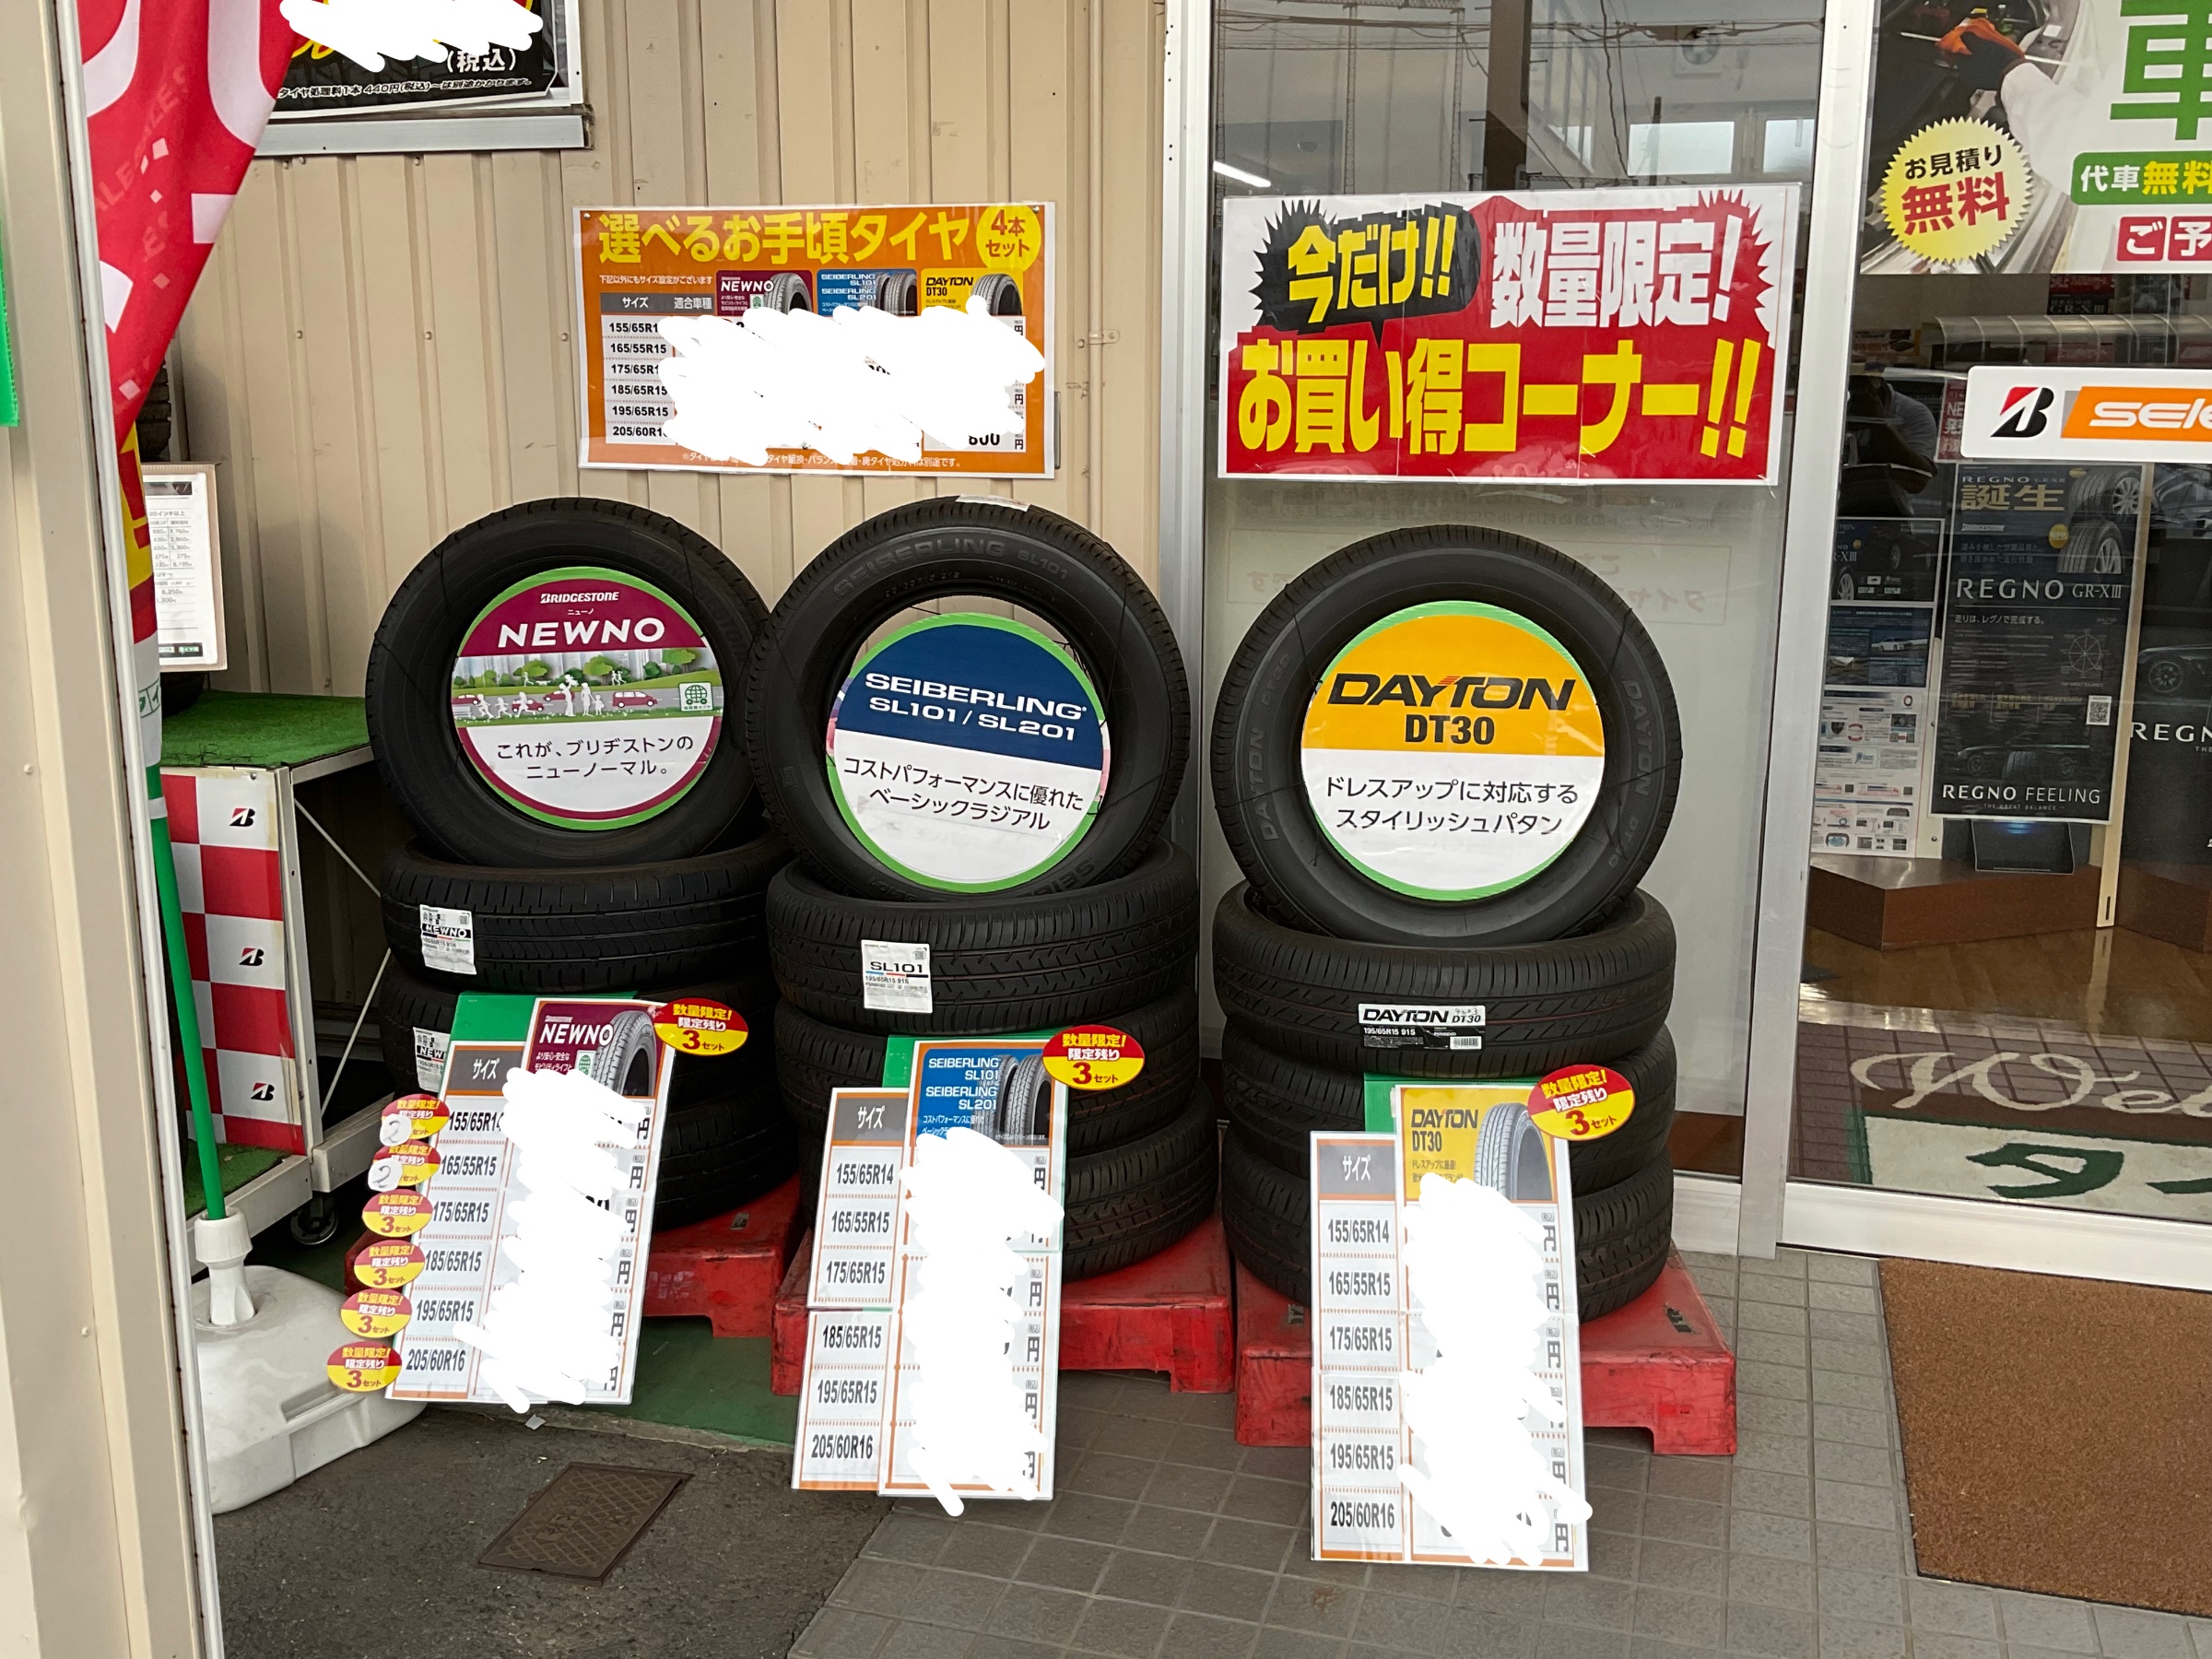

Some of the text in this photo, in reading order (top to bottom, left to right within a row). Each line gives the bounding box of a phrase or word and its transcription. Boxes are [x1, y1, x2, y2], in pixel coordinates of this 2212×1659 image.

[1904, 144, 2003, 180] お見積り
[1900, 171, 2010, 236] 無料
[599, 212, 970, 265] 選べるお手頃タイヤ
[991, 217, 1026, 238] 4本
[985, 240, 1030, 257] セット
[1288, 214, 1458, 324] 今だけ!!
[1490, 215, 1742, 328] 数量限定!
[721, 280, 774, 292] NEWNO
[925, 276, 973, 287] DAYTON
[926, 287, 947, 297] DT30
[621, 297, 649, 309] サイズ
[674, 297, 712, 310] 適合車種
[610, 343, 667, 354] 165/55R15
[611, 384, 668, 395] 185/65R15
[1238, 337, 1760, 459] お買い得コーナー!!
[612, 406, 669, 417] 195/65R15
[1960, 484, 2065, 512] 誕生
[540, 591, 620, 605] BRIDGESTONE
[1956, 578, 2065, 600] REGNO
[566, 607, 595, 617] ニューノ
[498, 617, 665, 648] NEWNO
[865, 672, 1088, 721] SEIBERLING
[1326, 673, 1576, 711] DAYTON
[868, 696, 956, 724] SL101
[977, 712, 1076, 741] SL201
[1405, 714, 1495, 746] DT30
[497, 735, 694, 760] これが、ブリヂストンの
[526, 759, 669, 780] ニューノーマル。
[843, 756, 1084, 812] コストパフォーマンスに優れた
[1325, 776, 1579, 806] ドレスアップに対応する
[1942, 783, 2101, 804] REGNO FEELING
[869, 785, 1052, 831] ベーシックラジアル
[1335, 807, 1563, 837] スタイリッシュパタン
[425, 924, 467, 938] NEWNO
[870, 960, 923, 973] SL101
[672, 1003, 733, 1021] 数量限定!
[1362, 1008, 1449, 1023] DAYTON
[1452, 1014, 1481, 1023] DT30
[539, 1023, 614, 1046] NEWNO
[677, 1017, 726, 1032] 限定残り
[1363, 1027, 1416, 1036] 195/65R15 91S
[1062, 1033, 1126, 1048] 数量限定!
[928, 1057, 999, 1069] SEIBERLING
[1066, 1048, 1121, 1061] 限定残り
[472, 1057, 500, 1081] サイズ
[964, 1069, 999, 1081] SL101
[925, 1086, 998, 1098] SEIBERLING
[1540, 1069, 1608, 1100] 数量限定!
[958, 1099, 997, 1111] SL201
[1552, 1087, 1608, 1112] 限定残り
[857, 1106, 885, 1130] サイズ
[1410, 1108, 1479, 1129] DAYTON
[1412, 1130, 1442, 1152] DT30
[441, 1154, 496, 1177] 165/55R15
[836, 1162, 894, 1186] 155/65R14
[1342, 1154, 1372, 1182] サイズ
[378, 1194, 424, 1206] 数量限定!
[379, 1206, 417, 1216] 限定残り
[433, 1200, 489, 1224] 175/65R15
[830, 1210, 890, 1234] 165/55R15
[1327, 1218, 1390, 1244] 155/65R14
[369, 1245, 415, 1257] 数量限定!
[371, 1256, 409, 1268] 限定残り
[425, 1249, 483, 1273] 185/65R15
[826, 1260, 1042, 1308] 175/65R15 円
[1328, 1271, 1391, 1296] 165/55R15
[357, 1291, 404, 1306] 数量限定!
[358, 1304, 396, 1316] 限定残り
[416, 1300, 475, 1323] 195/65R15
[342, 1347, 391, 1359] 数量限定!
[822, 1324, 1041, 1363] 185/65R15 円
[1329, 1325, 1561, 1369] 175/65R15 円
[345, 1359, 385, 1370] 限定残り
[406, 1348, 466, 1372] 205/60R16
[817, 1379, 877, 1405] 195/65R15
[1329, 1384, 1394, 1411] 185/65R15
[811, 1433, 874, 1460] 205/60R16
[1330, 1443, 1394, 1471] 195/65R15
[1330, 1501, 1395, 1529] 205/60R16
